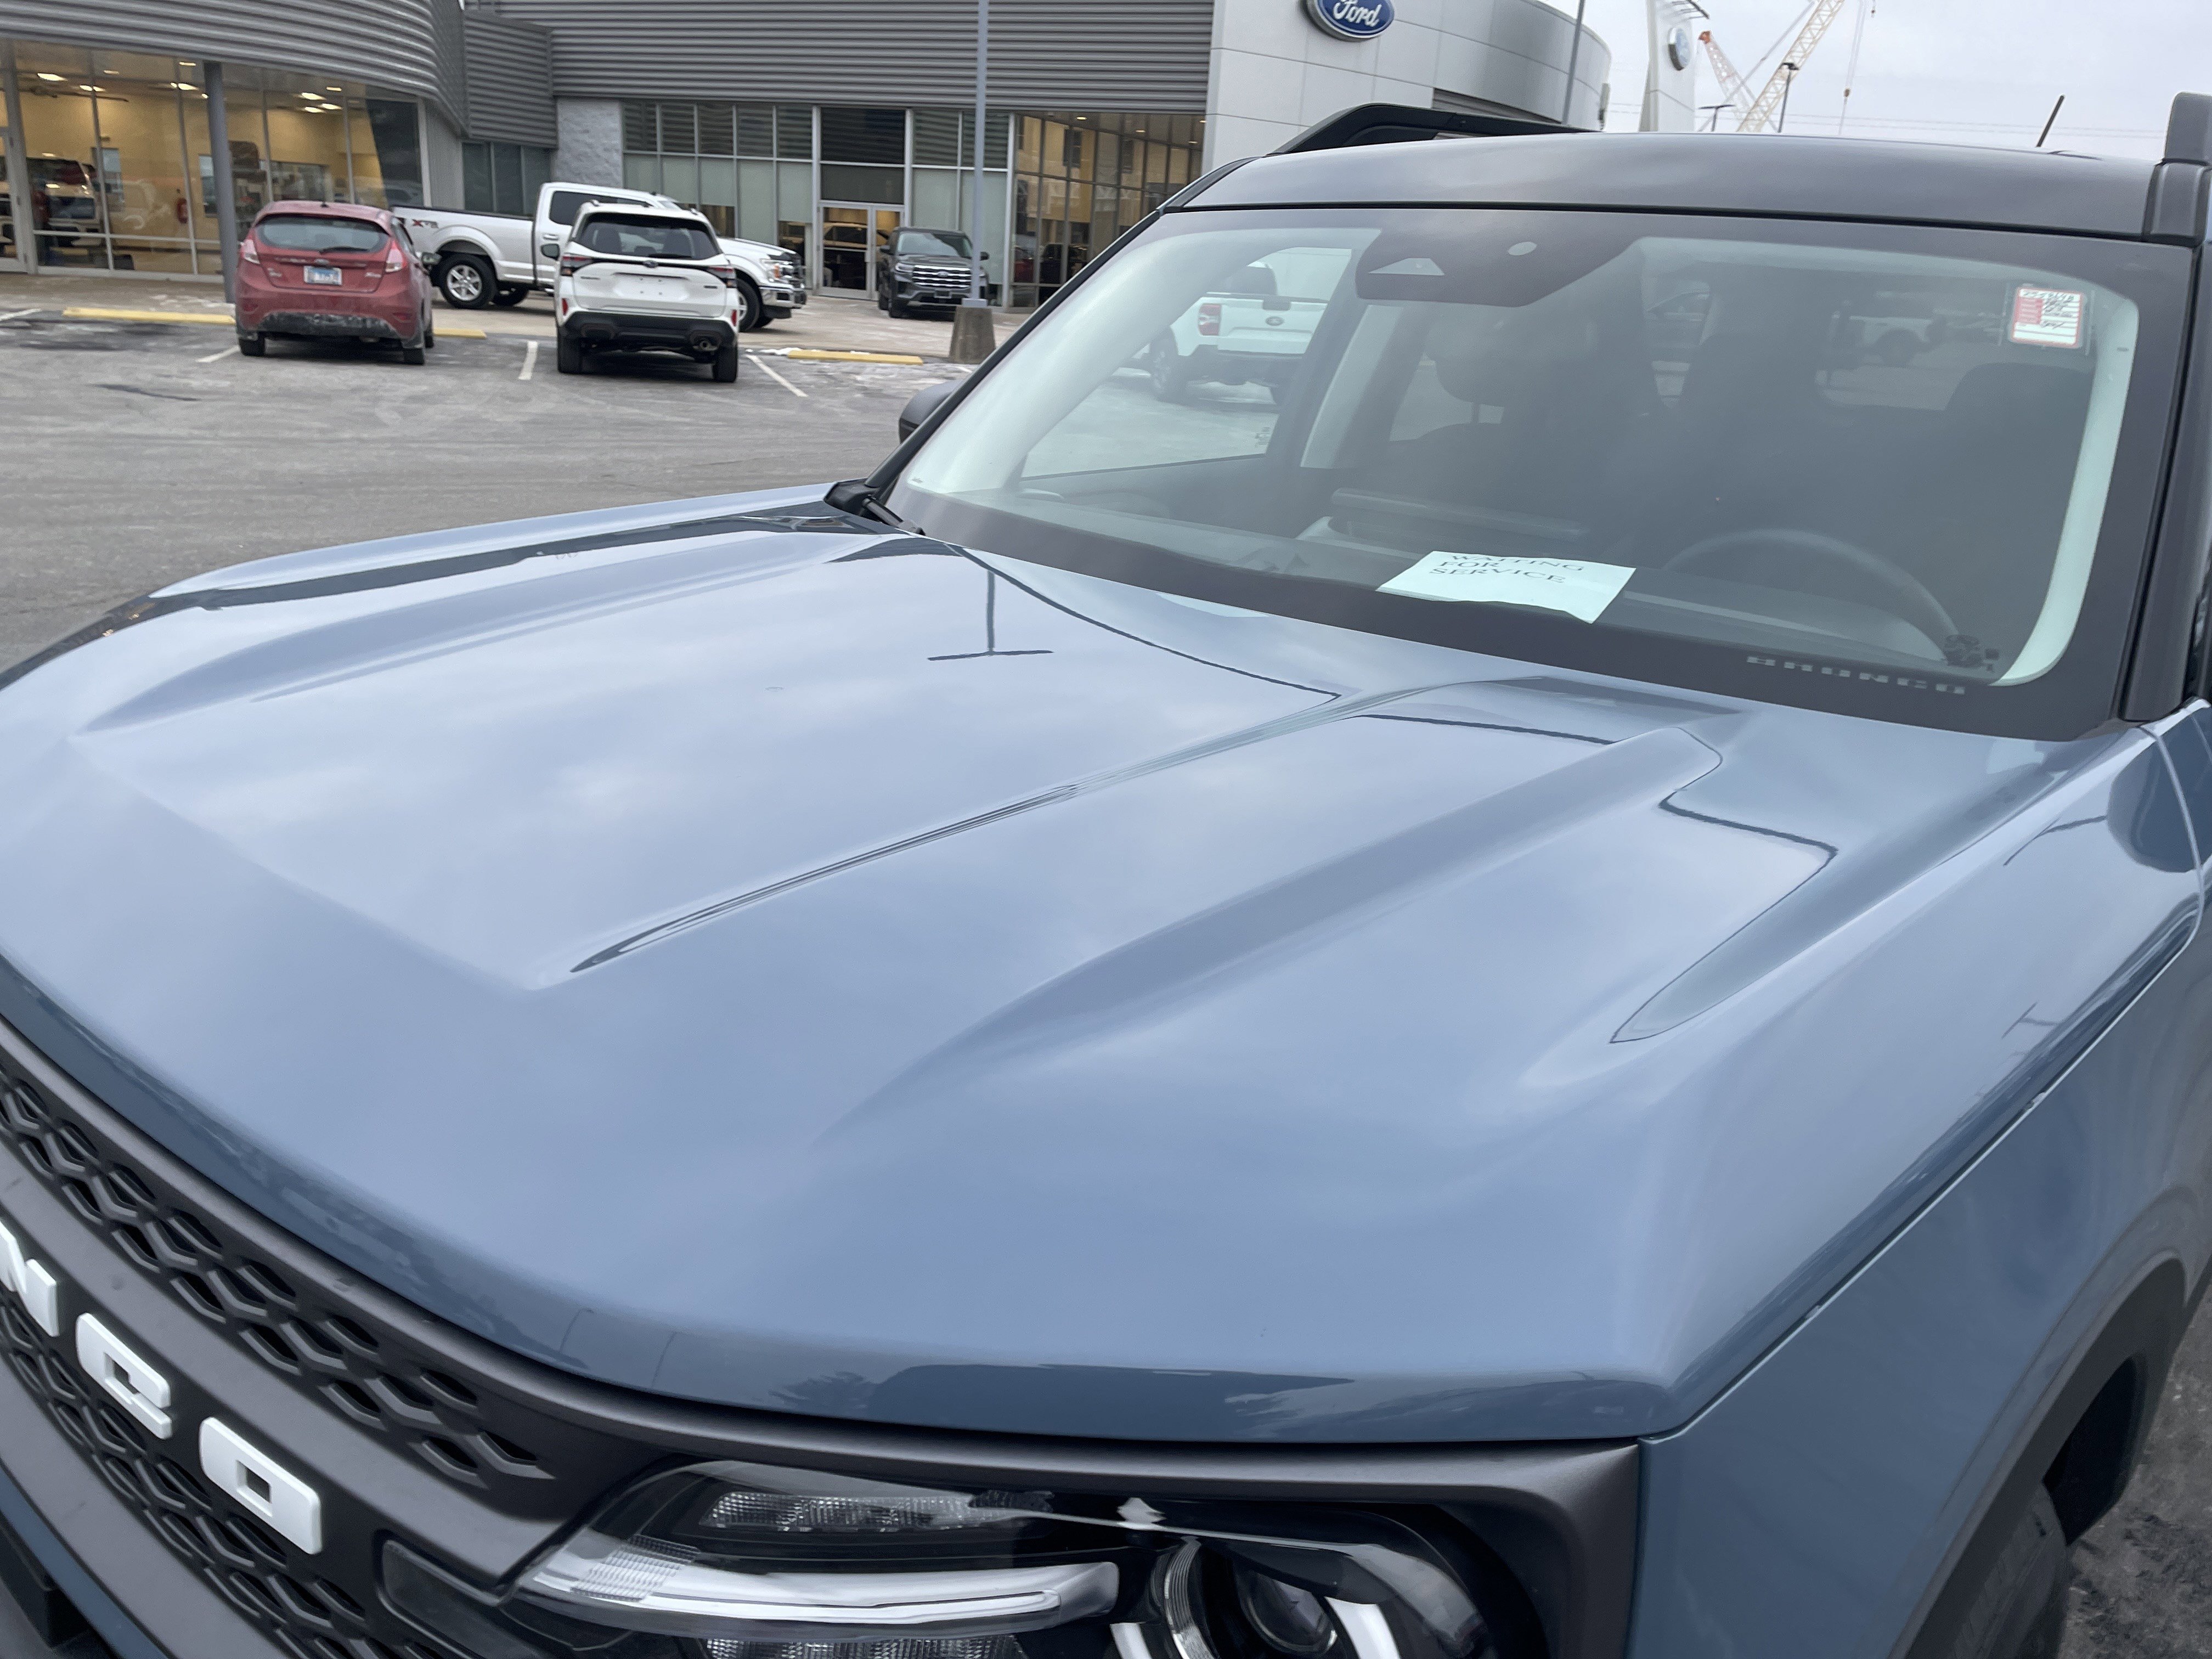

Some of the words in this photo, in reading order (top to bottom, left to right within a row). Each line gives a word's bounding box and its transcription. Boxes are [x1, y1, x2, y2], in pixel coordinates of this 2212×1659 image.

[1333, 0, 1381, 26] Ford
[1453, 556, 1584, 571] WAITING
[1430, 568, 1566, 583] SERVICE
